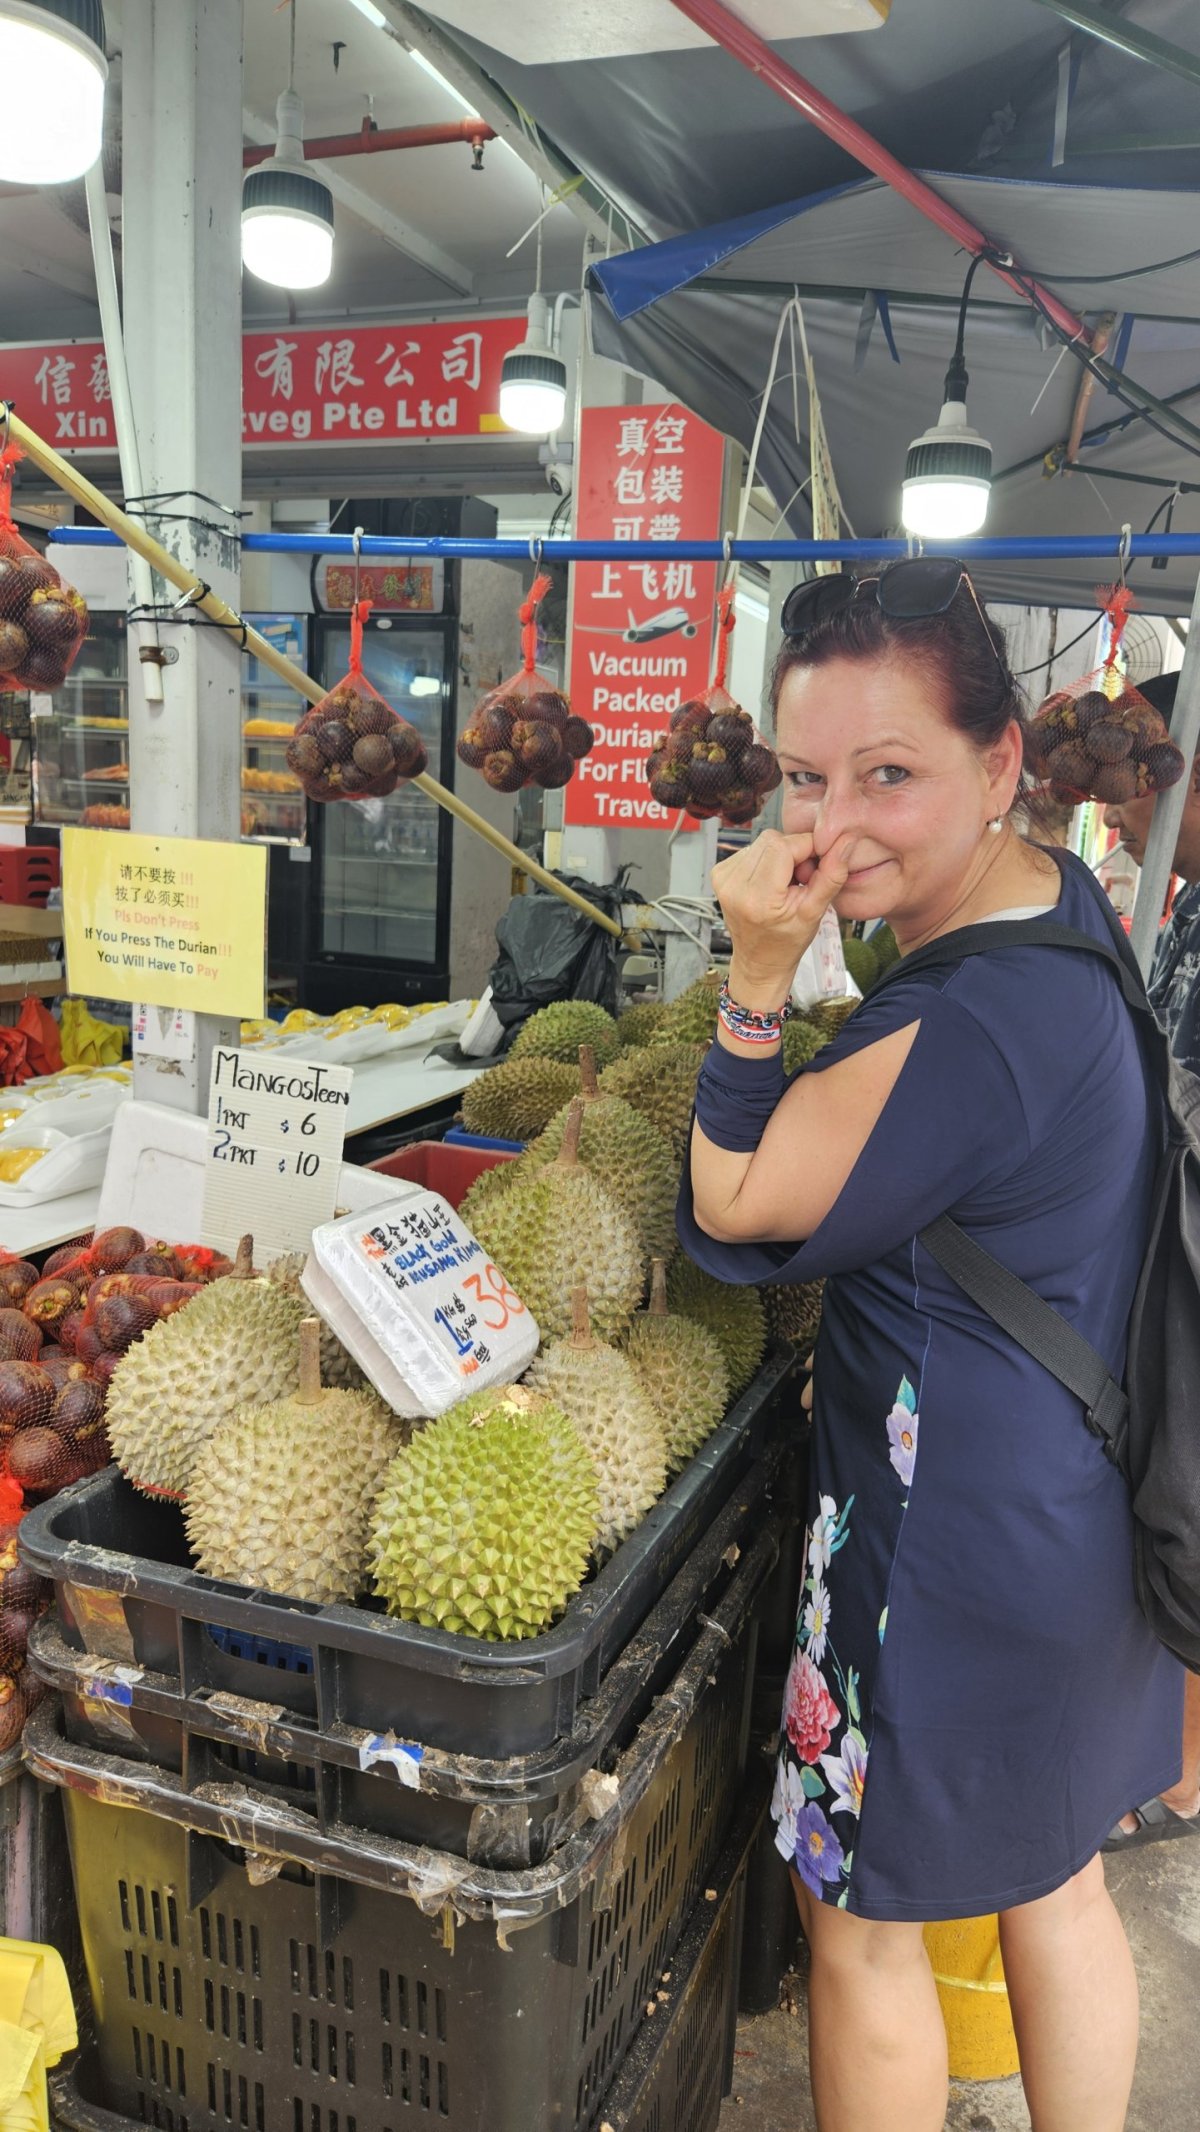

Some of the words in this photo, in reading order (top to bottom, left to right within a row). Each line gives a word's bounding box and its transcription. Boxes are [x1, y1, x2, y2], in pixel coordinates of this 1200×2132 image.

[254, 331, 483, 401] 有限公司
[55, 411, 107, 438] Xin
[323, 402, 385, 431] Pte
[396, 398, 458, 429] Ltd
[615, 416, 687, 457] 真空
[613, 465, 684, 505] 包装
[591, 561, 697, 600] 上飞机
[589, 651, 688, 677] Vacuum
[592, 687, 681, 713] Packed
[588, 722, 672, 748] Durian
[579, 757, 619, 782] For
[594, 793, 669, 820] Travel
[120, 864, 176, 884] 请不要按
[114, 909, 131, 923] Pls
[134, 911, 167, 926] Don't
[169, 916, 200, 931] Press
[85, 927, 94, 940] If
[95, 929, 118, 942] You
[121, 932, 151, 947] Press
[154, 936, 175, 950] The
[97, 950, 119, 964] You
[122, 953, 145, 968] Will
[148, 957, 177, 972] Have
[179, 961, 194, 974] To
[196, 963, 219, 980] Pay
[408, 1254, 459, 1284] MUSANG
[453, 1240, 484, 1263] KING
[462, 1263, 525, 1329] 38
